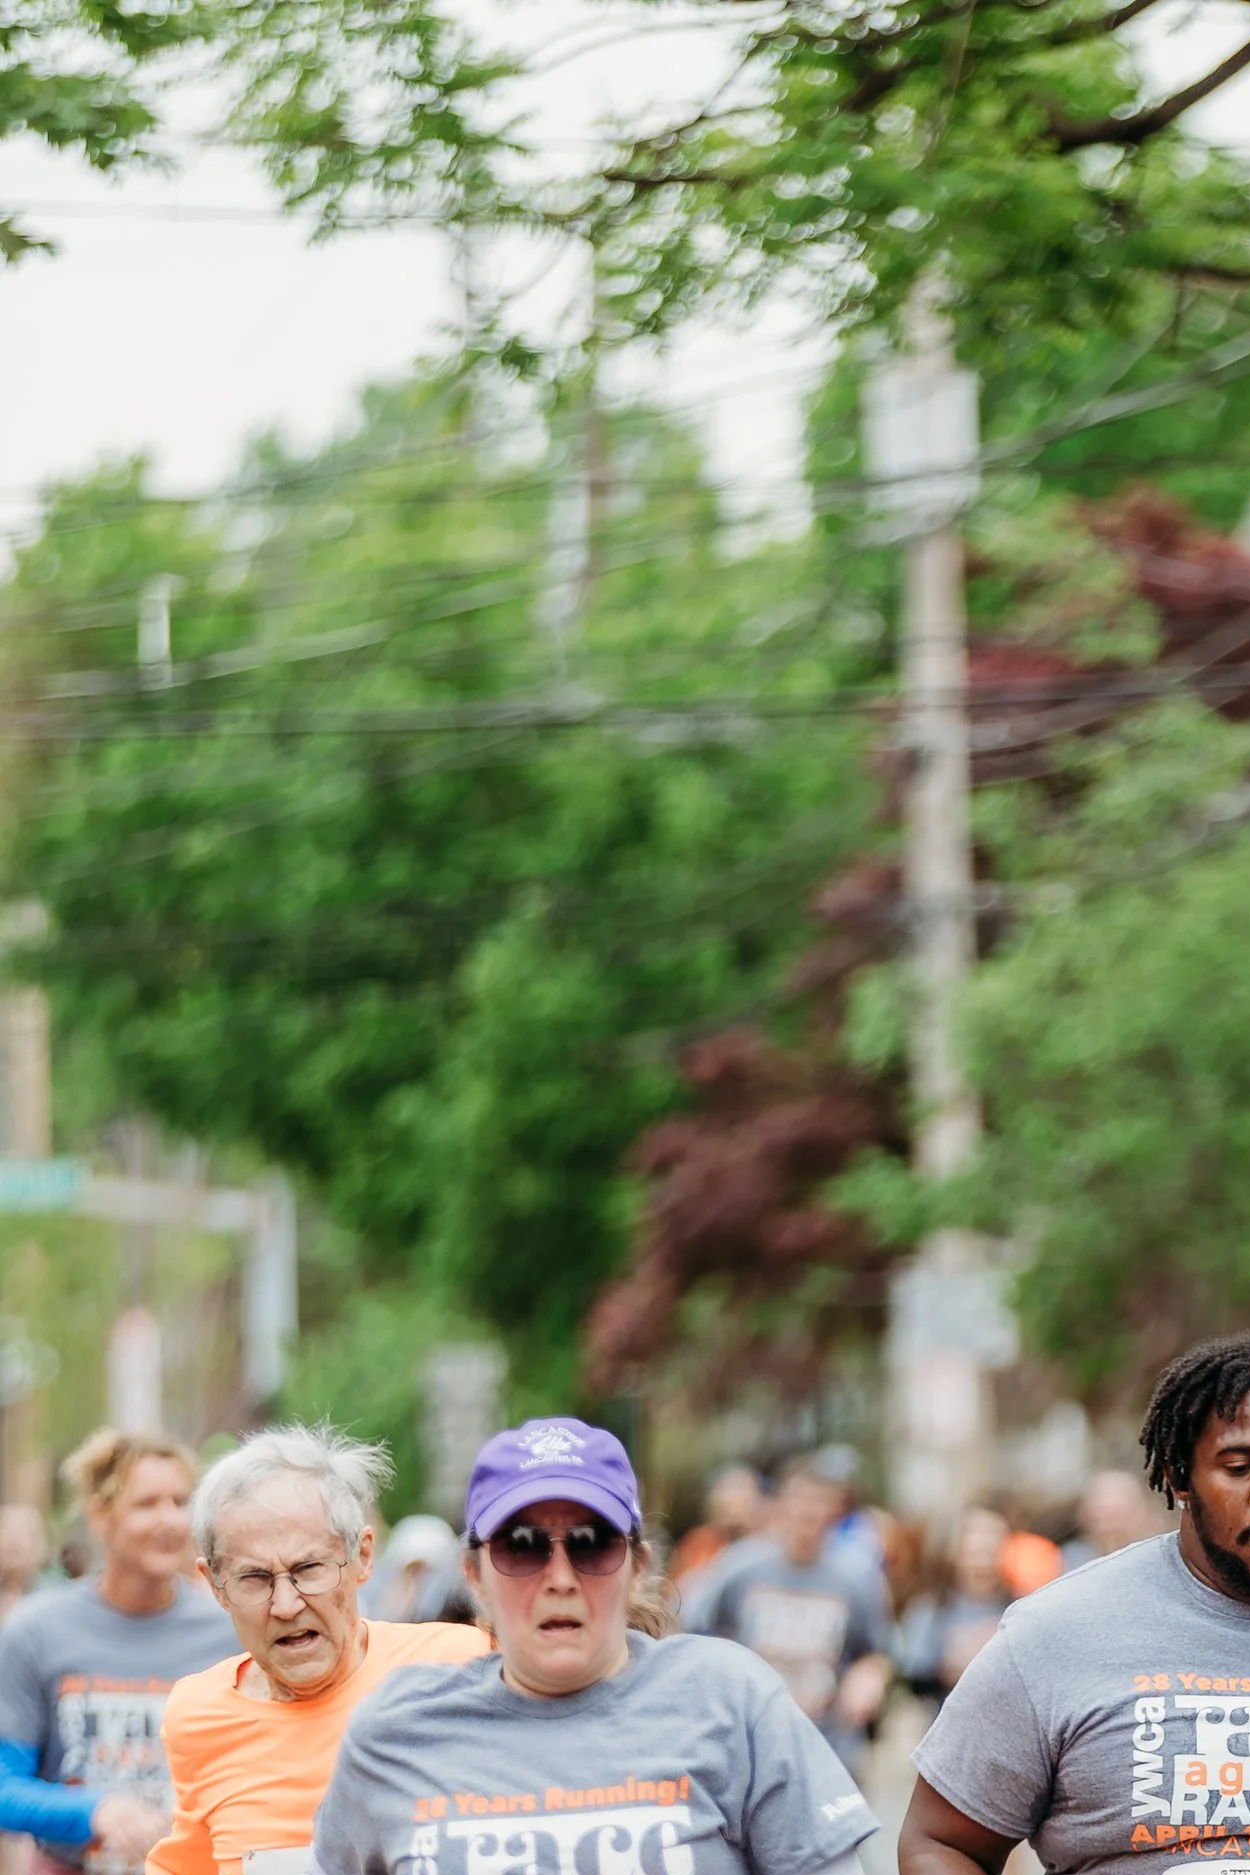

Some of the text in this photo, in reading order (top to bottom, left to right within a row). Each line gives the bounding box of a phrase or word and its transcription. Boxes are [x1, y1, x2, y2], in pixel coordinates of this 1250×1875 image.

[1133, 1674, 1170, 1692] 28
[1131, 1696, 1171, 1818] ywca
[454, 1792, 537, 1816] Years
[544, 1774, 690, 1810] Running!
